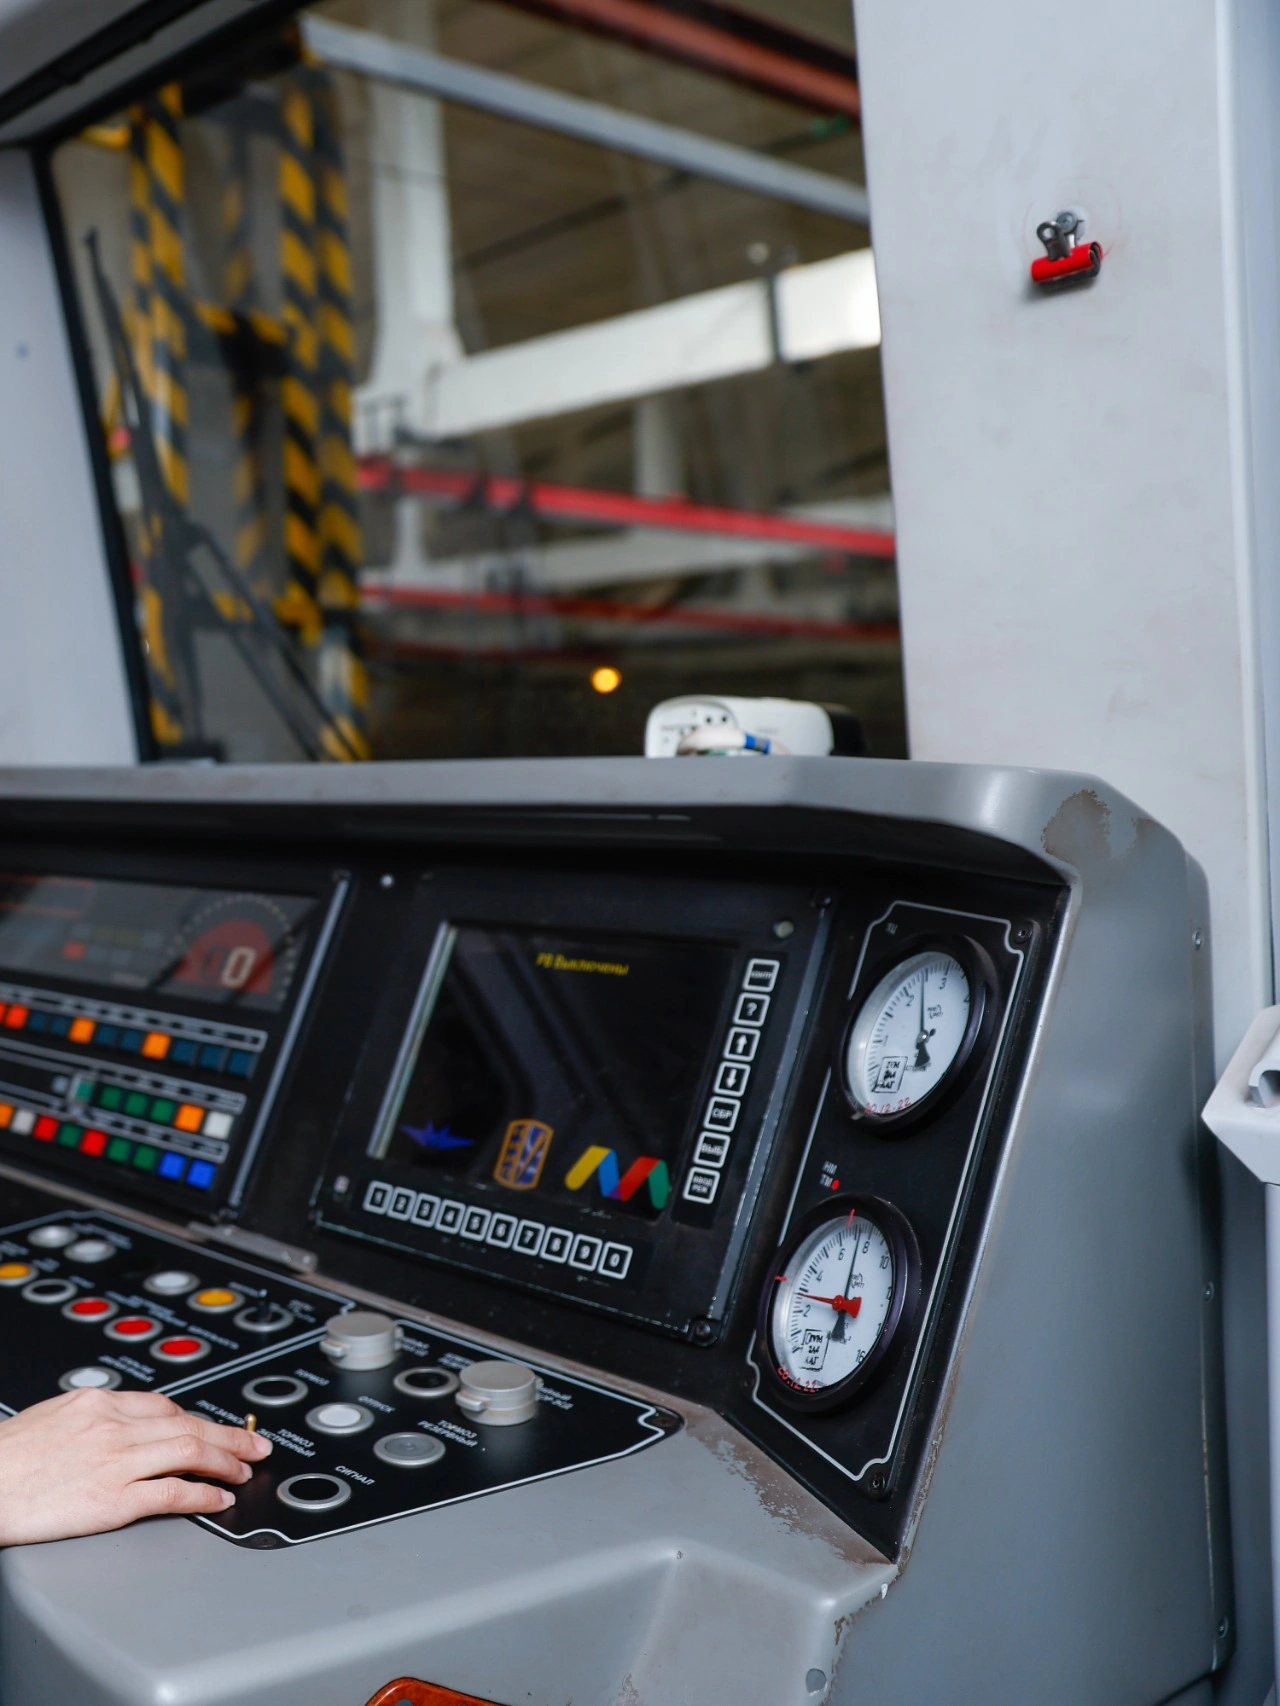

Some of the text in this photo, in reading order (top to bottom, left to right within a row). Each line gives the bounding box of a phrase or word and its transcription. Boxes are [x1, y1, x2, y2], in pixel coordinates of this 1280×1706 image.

[939, 977, 948, 990] 3
[906, 994, 915, 1007] 2
[712, 1107, 733, 1119] СБР
[838, 1248, 846, 1261] 6
[862, 1241, 870, 1254] 8
[879, 1255, 890, 1270] 10
[803, 1304, 811, 1318] 2
[855, 1349, 866, 1363] 16
[418, 1420, 478, 1448] РЕЗЕРВНЫЙ
[437, 1419, 478, 1439] ТОРМОЗ
[257, 1428, 316, 1458] ЭКСТРЕННЫЙ
[277, 1428, 315, 1448] ТОРМОЗ
[335, 1465, 376, 1485] СИГНАЛ
